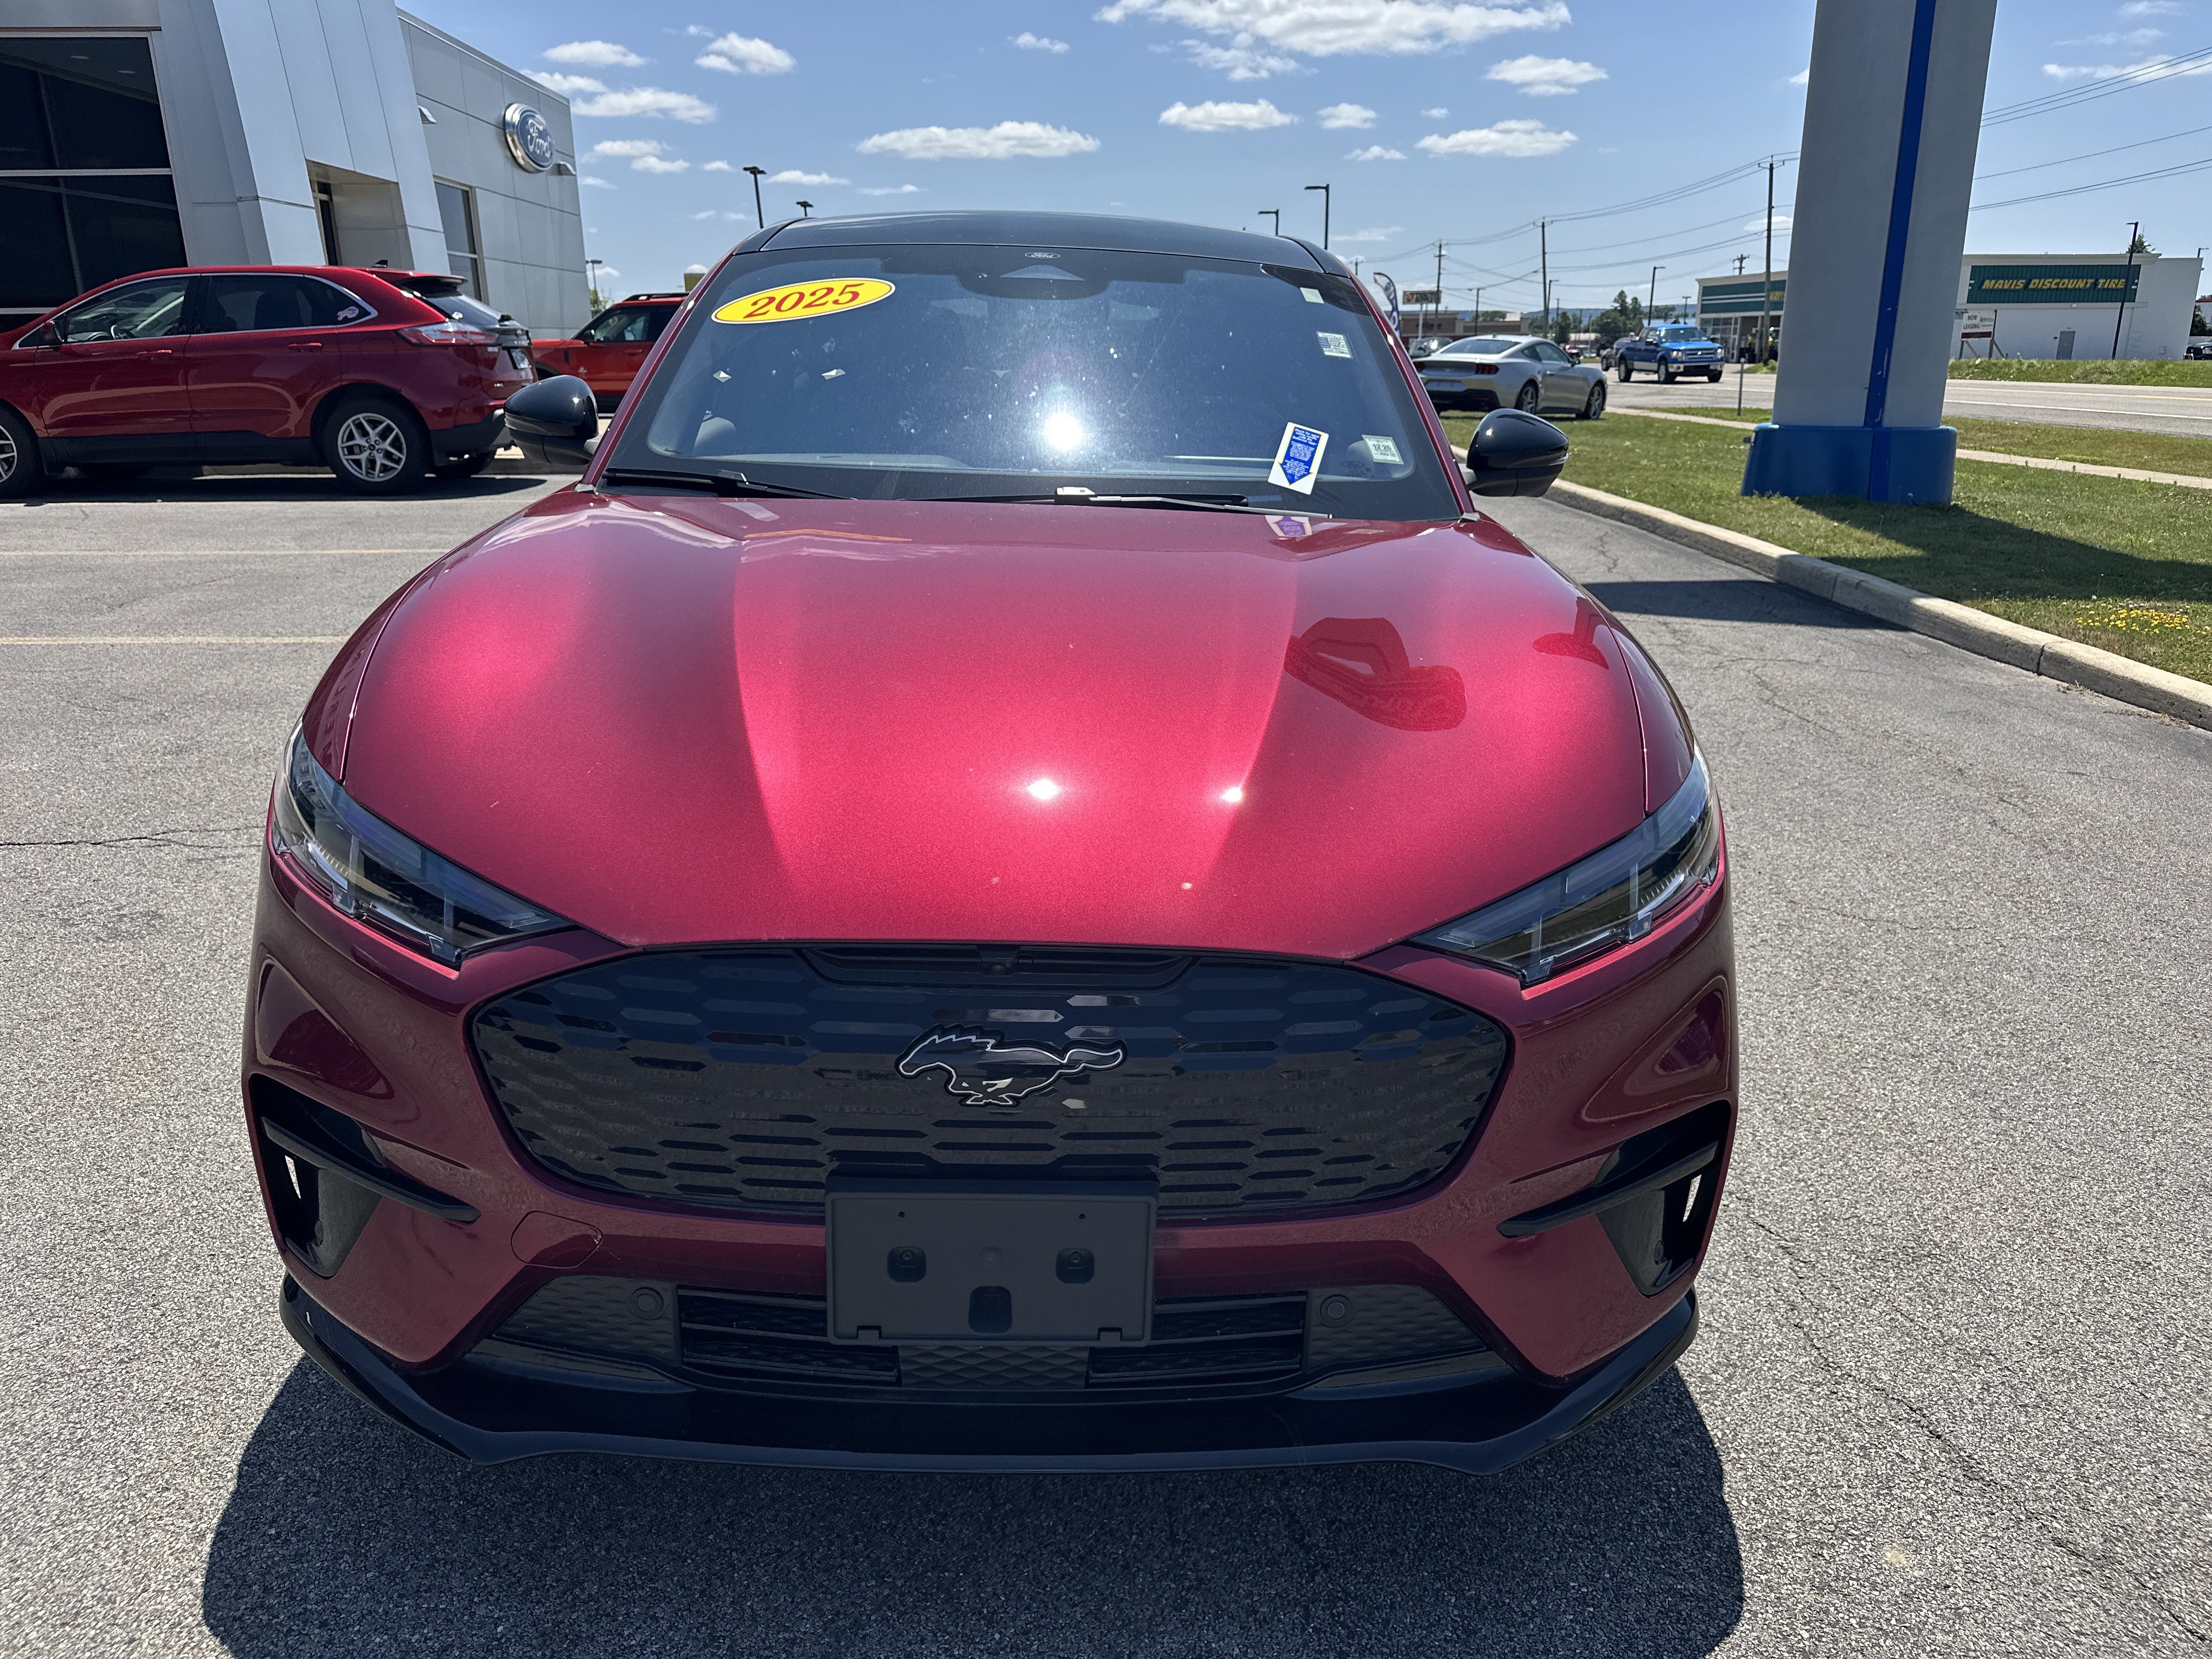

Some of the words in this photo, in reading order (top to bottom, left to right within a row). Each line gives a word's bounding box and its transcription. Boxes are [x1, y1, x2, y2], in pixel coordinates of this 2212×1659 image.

[527, 119, 554, 157] Ford
[742, 283, 865, 319] 2025
[1982, 279, 2026, 290] MAVIS
[2029, 278, 2095, 289] DISCOUNT
[2097, 278, 2126, 289] TIRE
